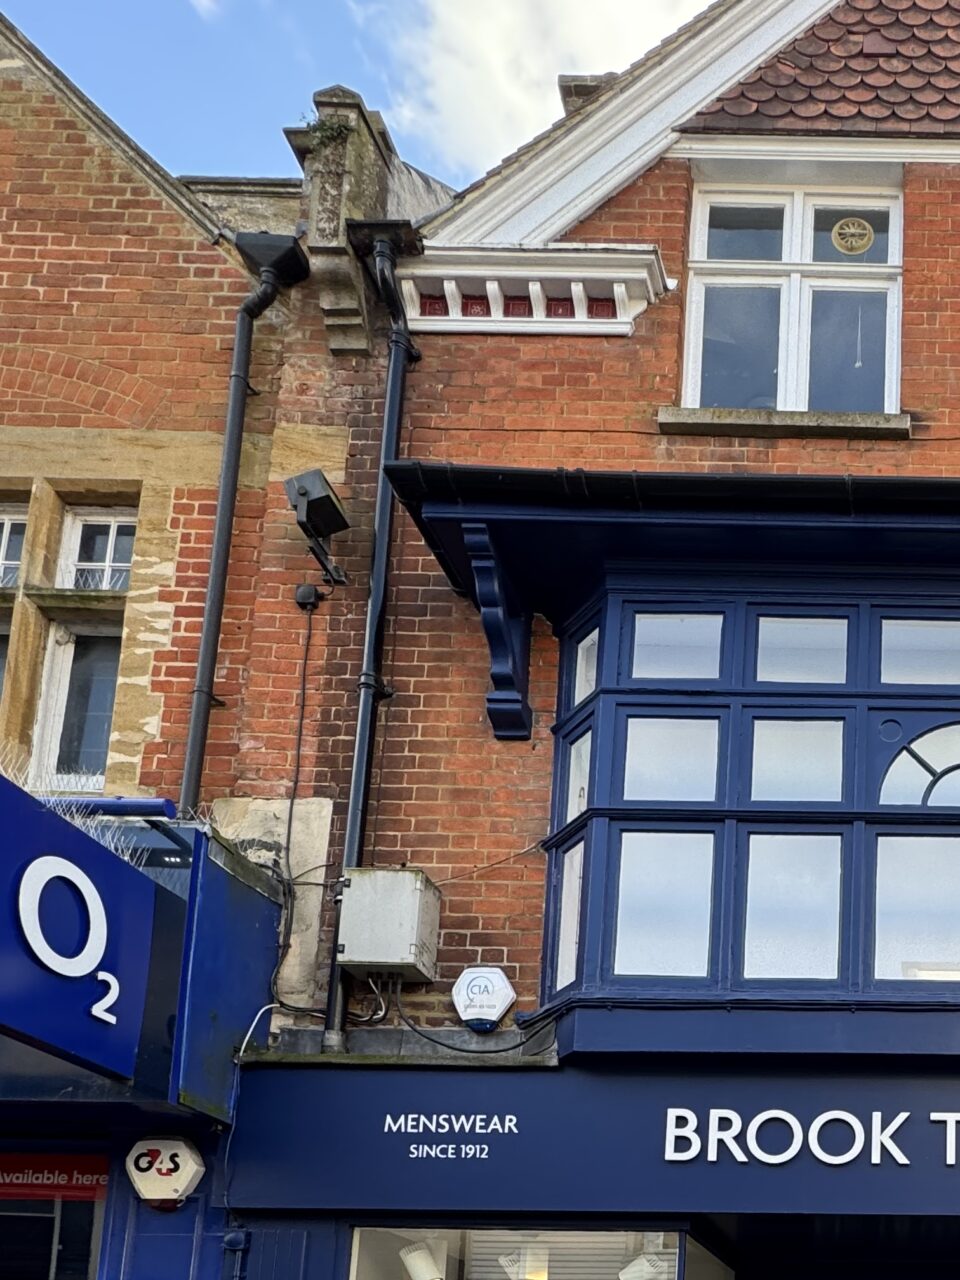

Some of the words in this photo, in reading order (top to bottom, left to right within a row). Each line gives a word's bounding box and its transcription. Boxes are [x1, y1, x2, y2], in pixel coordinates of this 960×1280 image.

[384, 1114, 519, 1133] MENSWEAR
[664, 1107, 911, 1165] BROOK
[408, 1144, 457, 1158] SINCE
[460, 1144, 489, 1158] 1912
[133, 1148, 181, 1177] G4S
[72, 1170, 109, 1185] here
